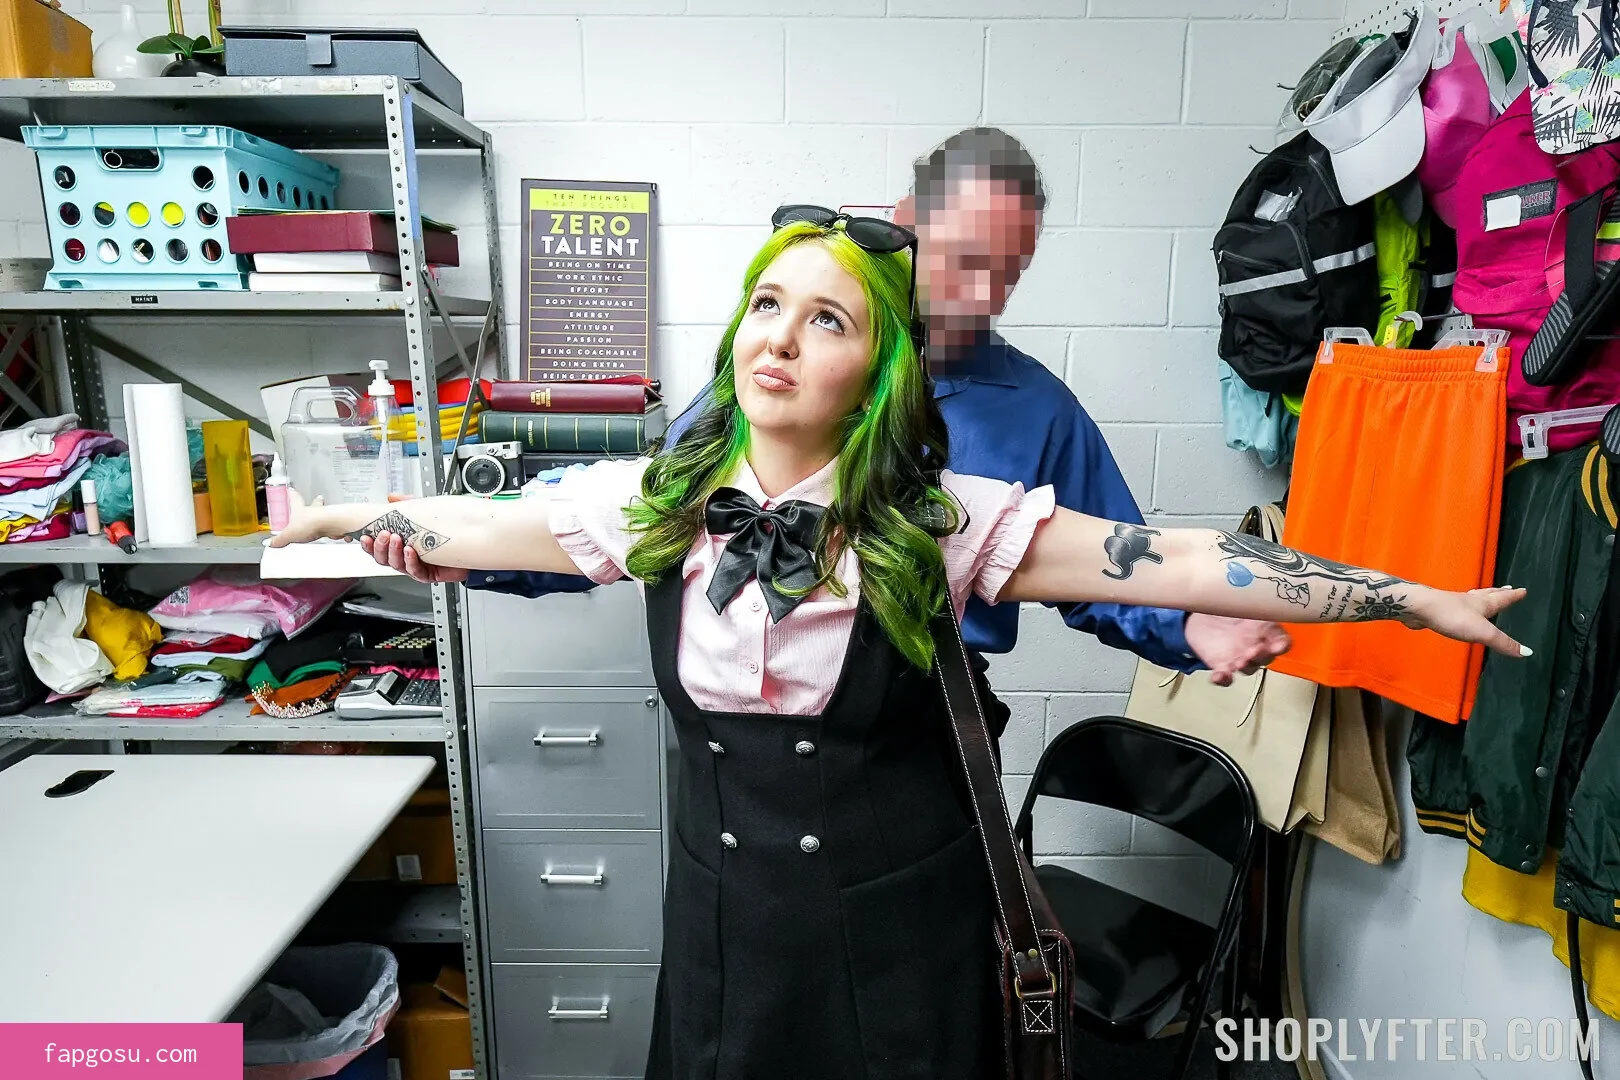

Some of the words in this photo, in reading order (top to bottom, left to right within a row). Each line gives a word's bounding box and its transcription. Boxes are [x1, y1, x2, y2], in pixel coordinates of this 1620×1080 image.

[583, 202, 635, 210] REQUIRE
[550, 213, 631, 236] ZERO
[541, 236, 640, 256] TALENT
[578, 299, 634, 307] LANGUAGE
[569, 311, 611, 319] ENERGY
[1327, 584, 1338, 601] Too
